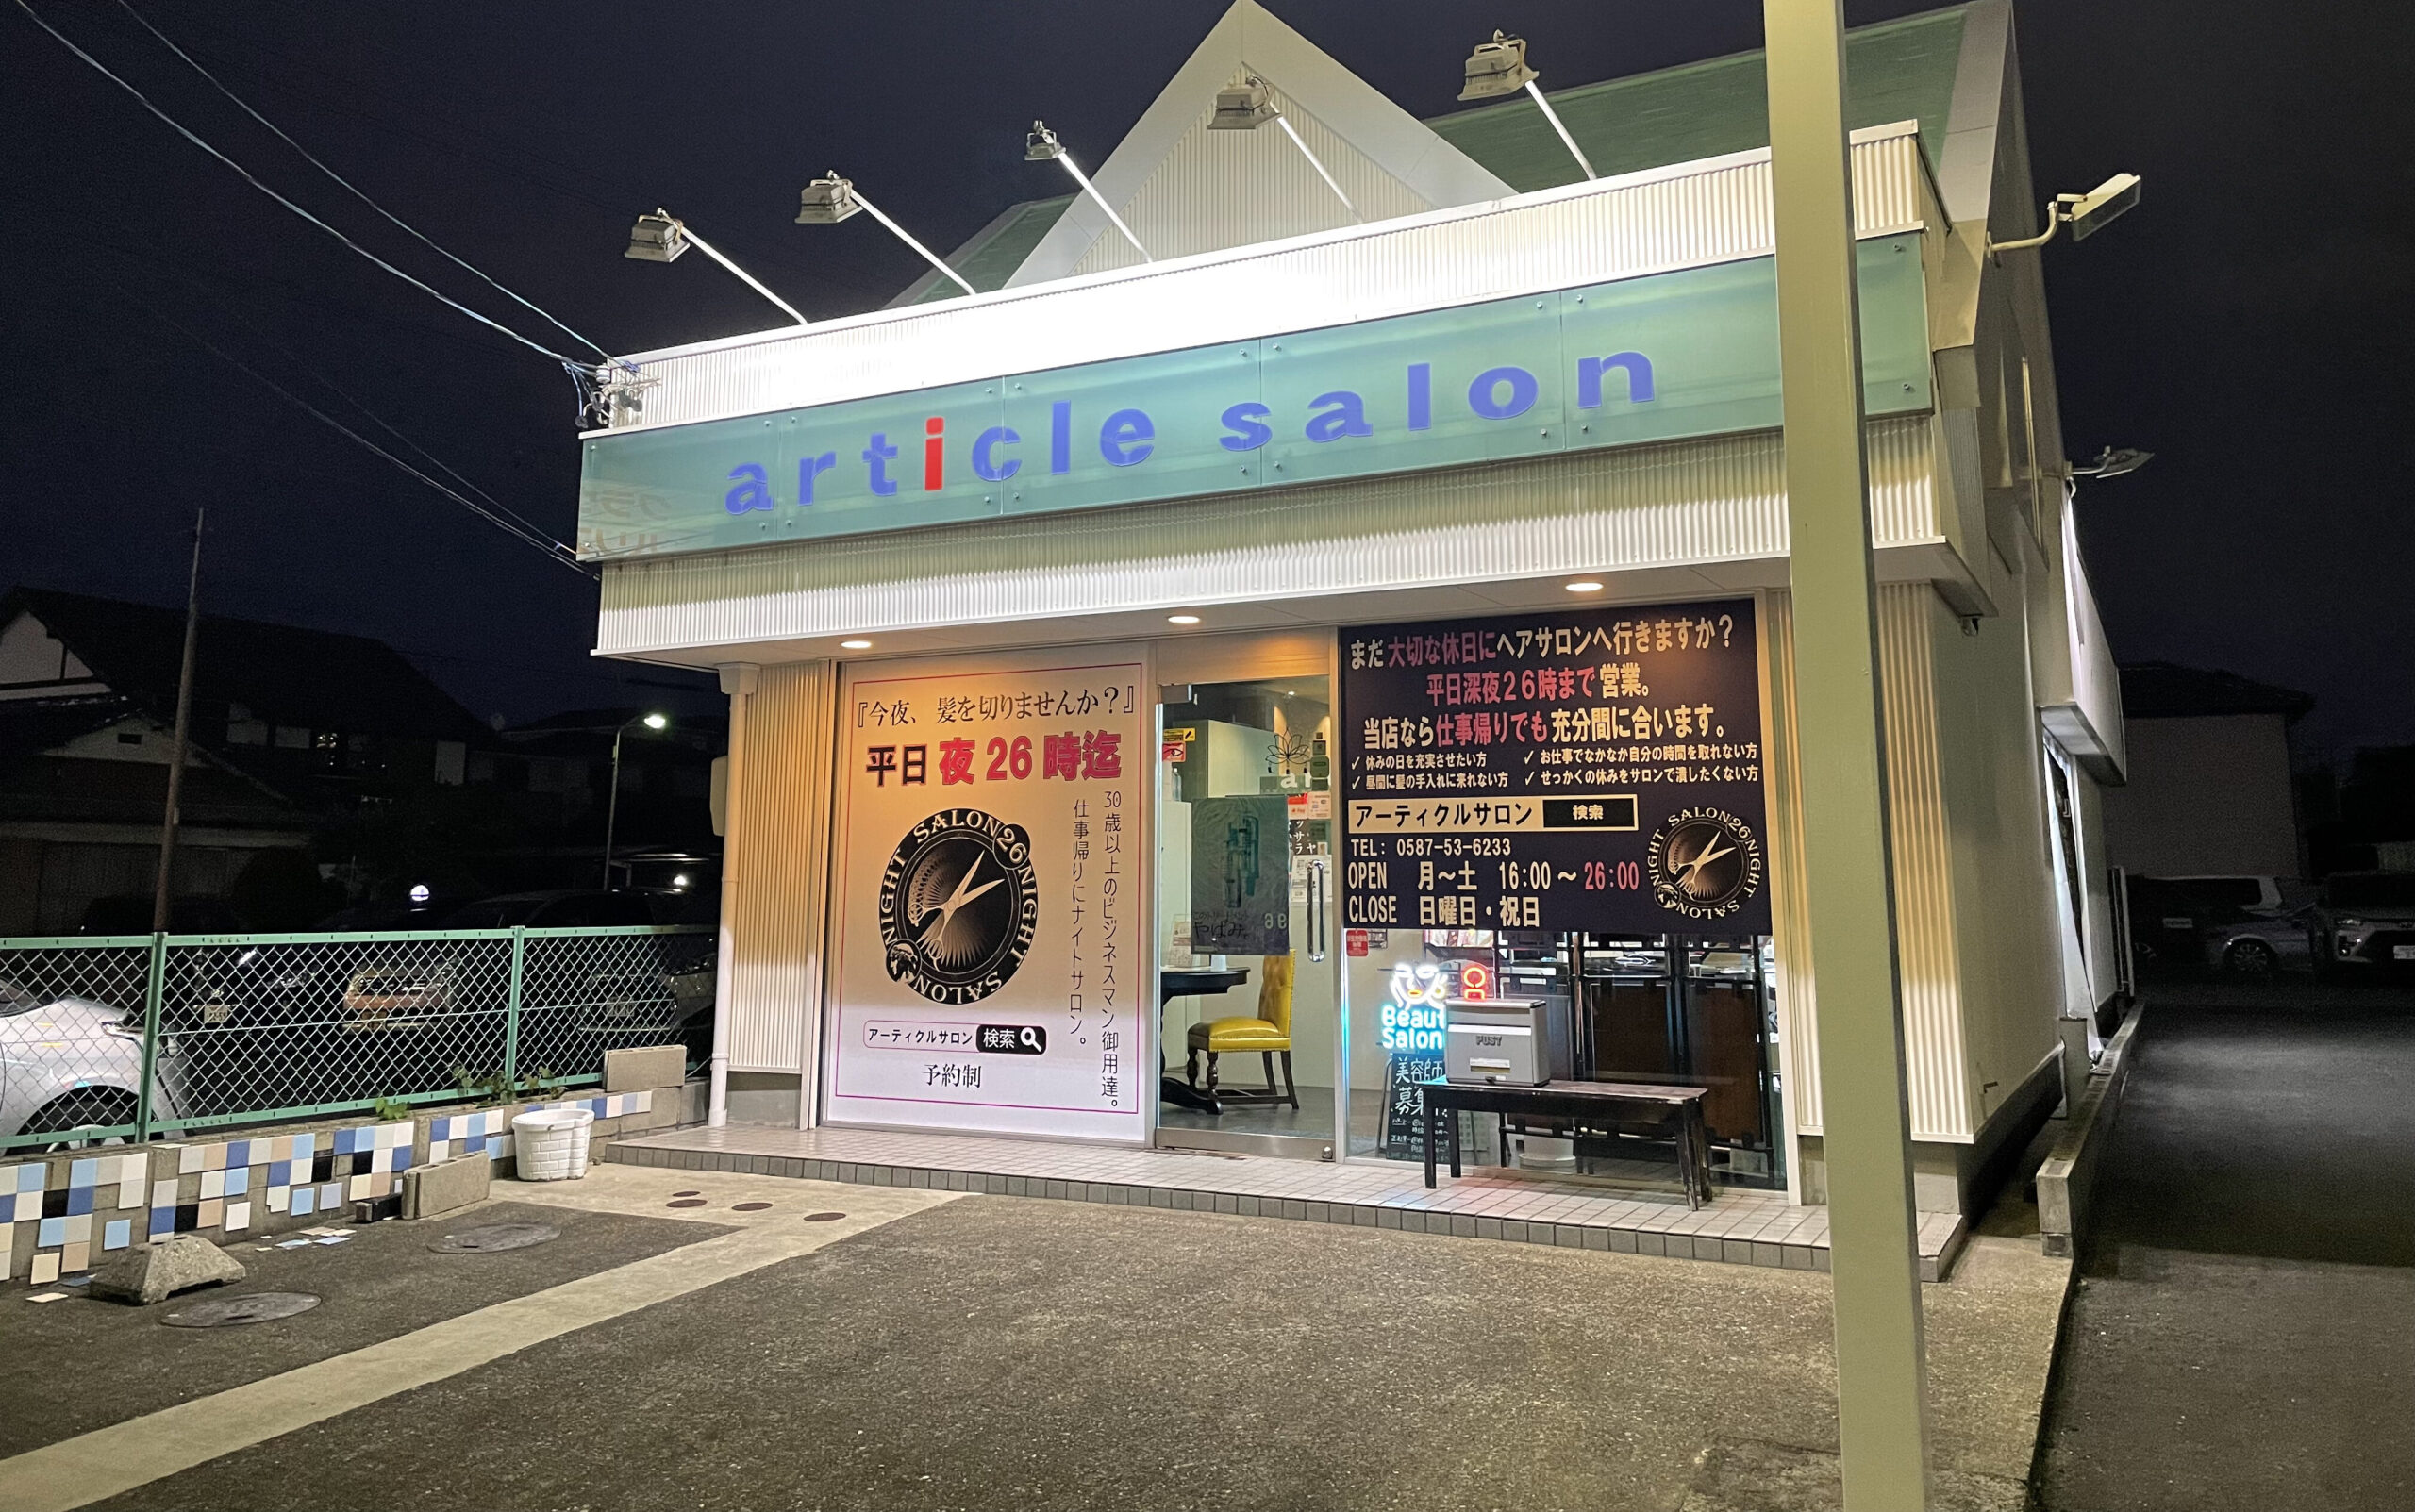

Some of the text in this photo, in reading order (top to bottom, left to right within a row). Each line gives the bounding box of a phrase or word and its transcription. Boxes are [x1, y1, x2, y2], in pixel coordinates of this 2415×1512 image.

[724, 350, 1656, 515] article salon
[1366, 752, 1487, 771] 休みの日を充実させたい方
[1541, 742, 1757, 765] お仕事でなかなか自分の時間を取れない方
[1366, 772, 1508, 790] 昼間に髪の手入れに来れない方
[1541, 764, 1758, 785] せっかくの休みをサロンで潰したくない方
[1356, 803, 1532, 828] アーティクルサロン
[1573, 805, 1604, 821] 検索
[1351, 838, 1511, 856] TEL: 0587-53-6233
[1348, 861, 1388, 889] OPEN
[1648, 806, 1761, 920] NIGHT SALON 26 NIGHT SALON
[881, 809, 1037, 1005] NIGHT SALON 26 NIGHT SALON
[1348, 896, 1540, 928] CLOSE 日曜日・祝日
[868, 1028, 1015, 1049] アーティクルサロン 検索
[1381, 1026, 1444, 1049] Salon
[1475, 1035, 1503, 1047] POST
[923, 1064, 982, 1089] 予約制
[1395, 1055, 1443, 1084] 美容師
